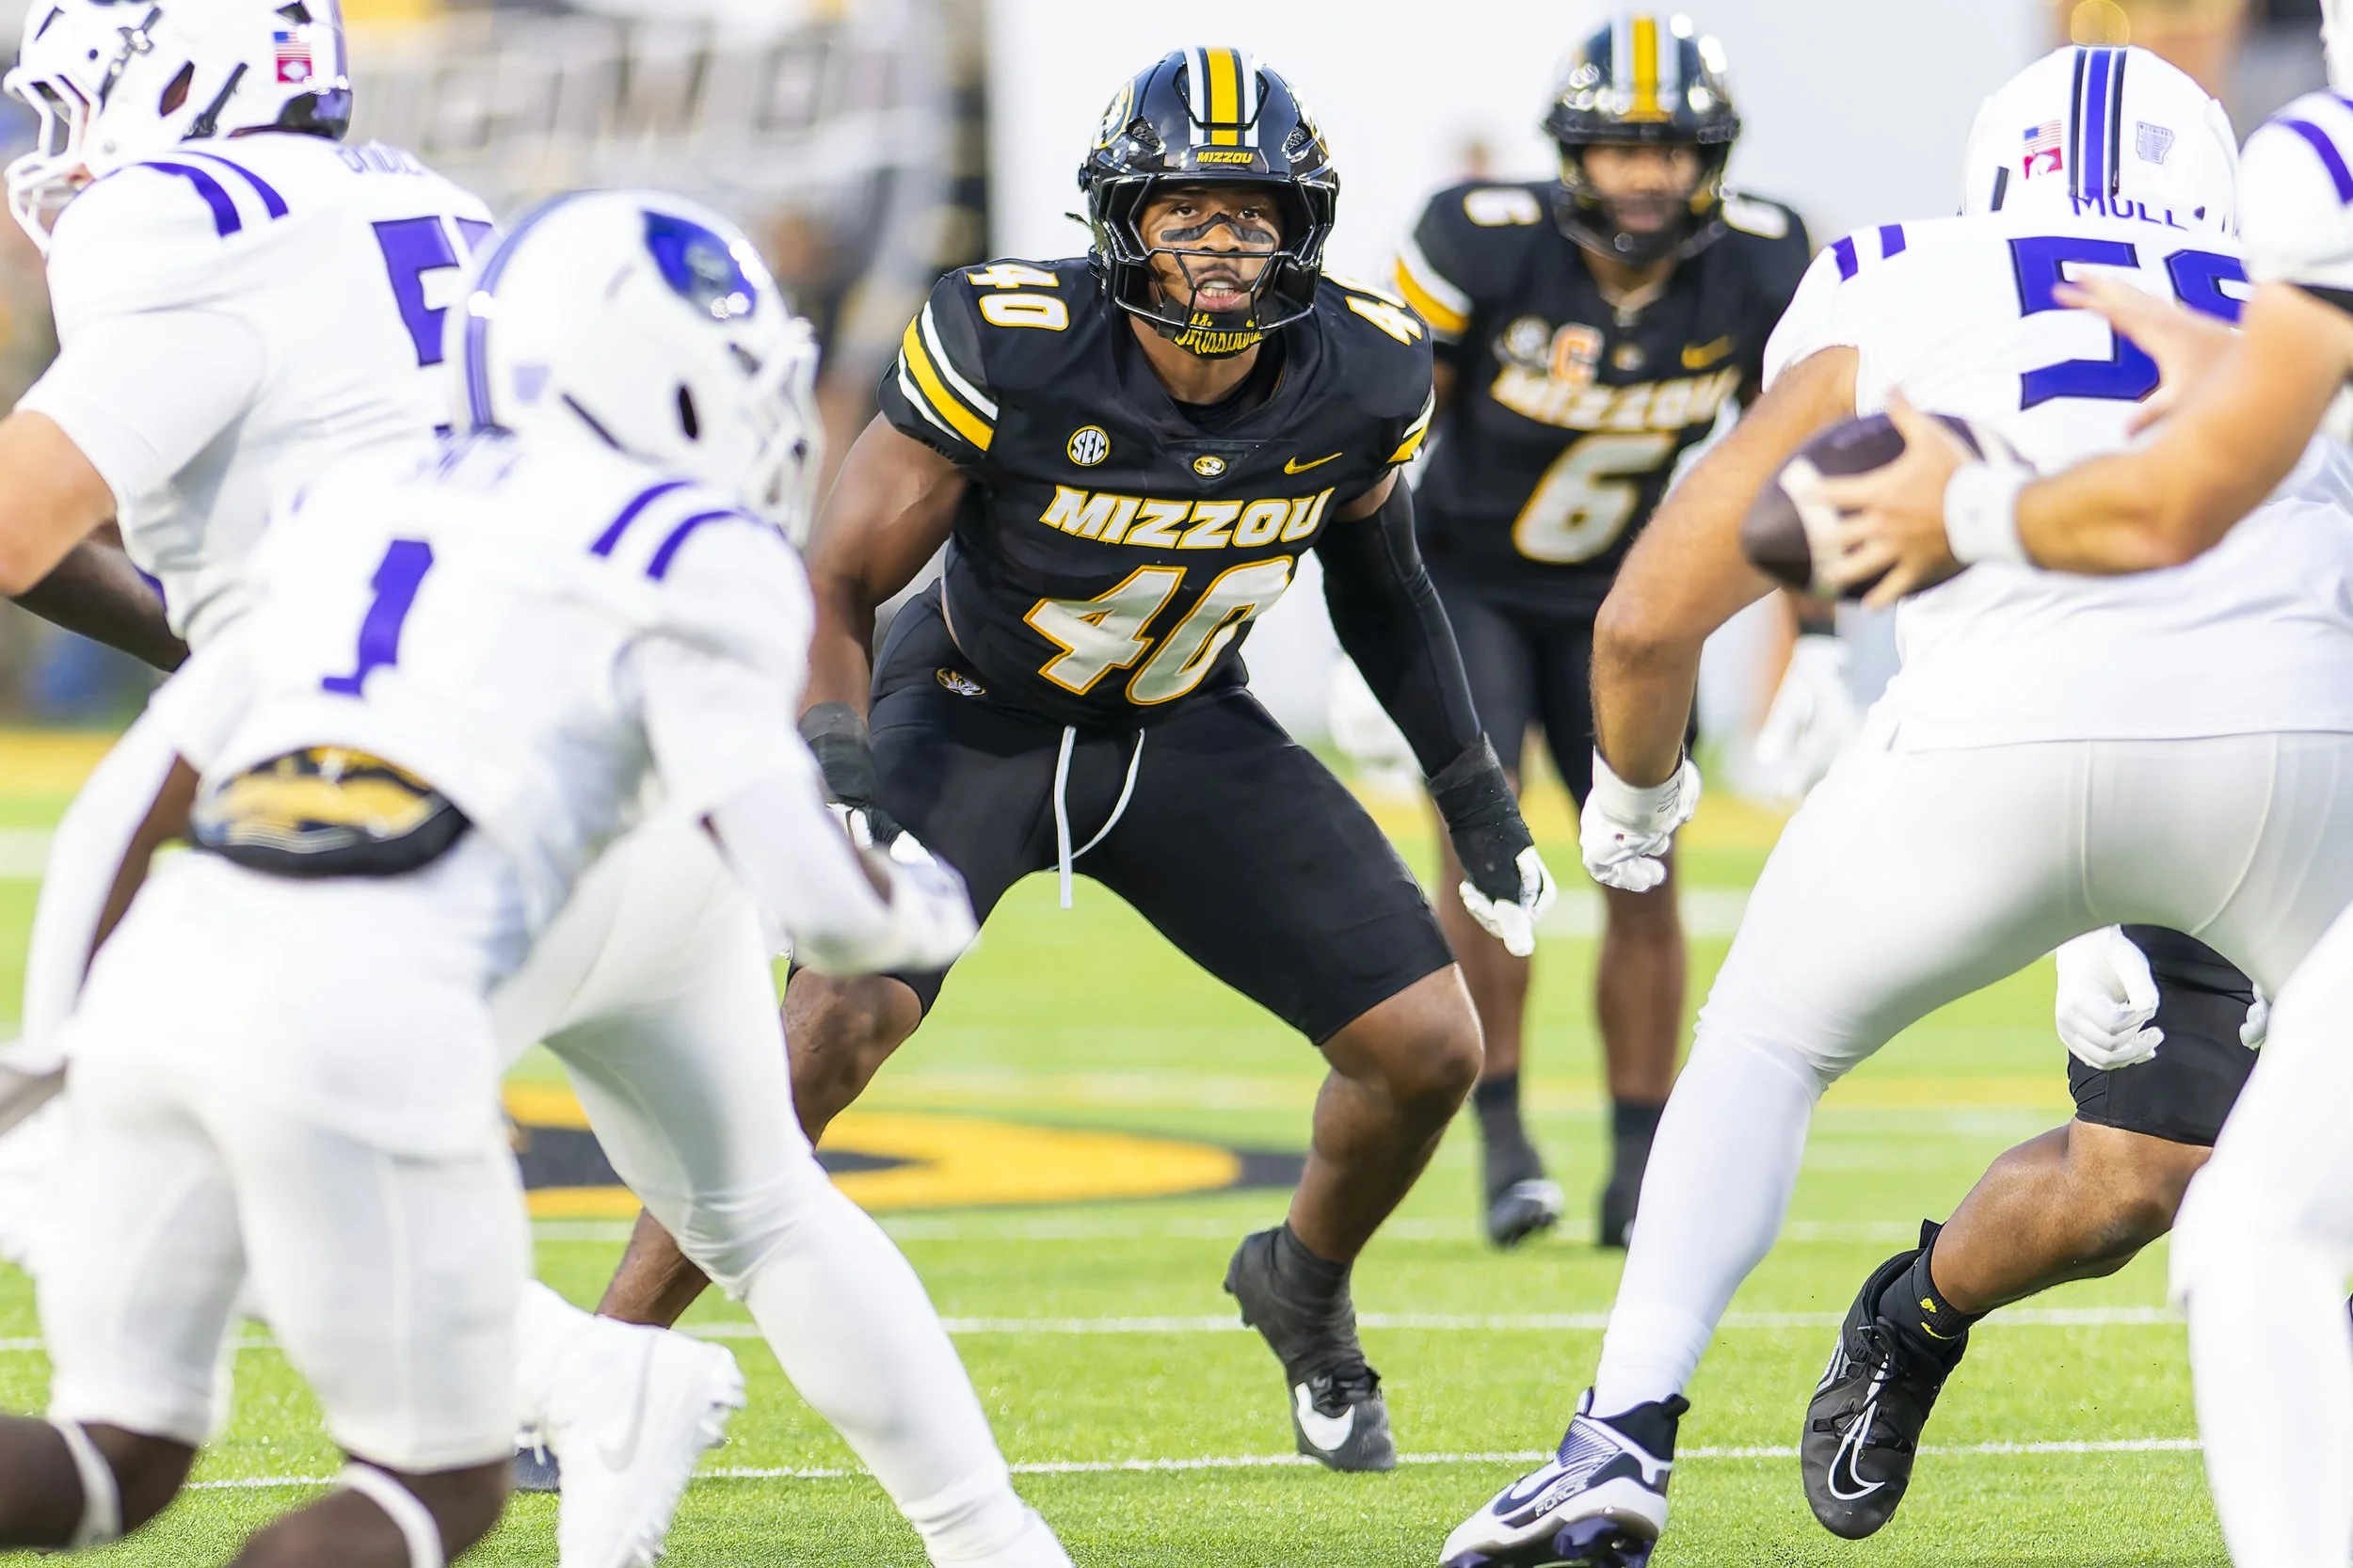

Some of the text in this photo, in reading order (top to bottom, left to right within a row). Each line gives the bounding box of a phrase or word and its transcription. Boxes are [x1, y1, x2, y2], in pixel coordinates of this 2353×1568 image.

[1195, 152, 1254, 164] MIZZOU
[371, 216, 493, 368] 5
[967, 263, 1070, 331] 40
[1554, 322, 1604, 386] C
[1070, 428, 1108, 464] SEC
[1039, 485, 1336, 550] MIZZOU
[1511, 430, 1678, 564] 6
[322, 539, 434, 696] 1
[1023, 555, 1294, 706] 40
